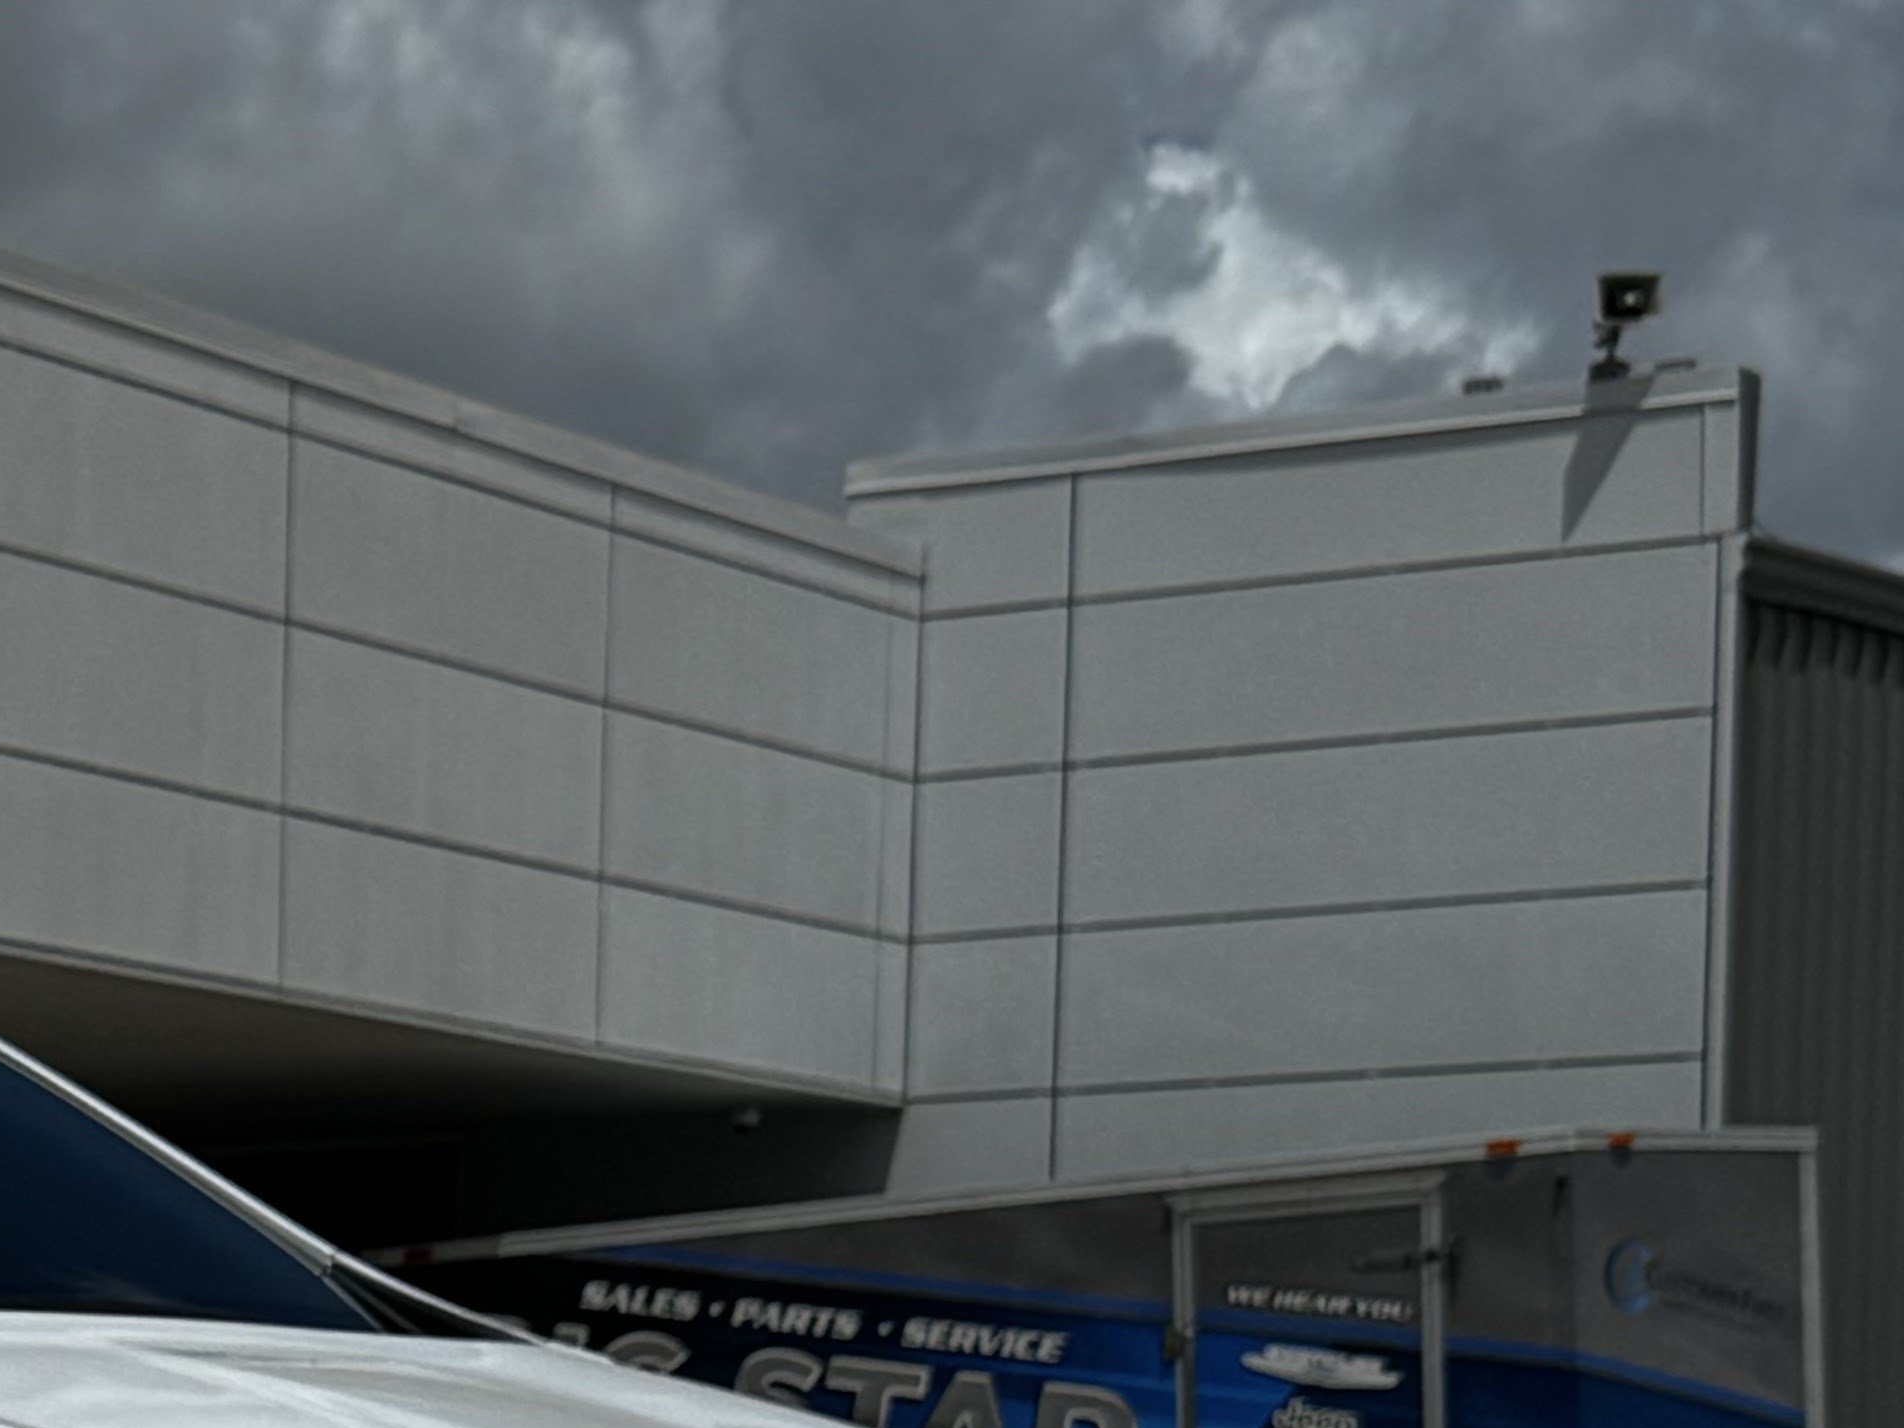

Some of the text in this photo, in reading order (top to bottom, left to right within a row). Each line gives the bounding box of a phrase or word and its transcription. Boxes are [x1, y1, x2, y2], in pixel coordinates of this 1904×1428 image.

[579, 1280, 1071, 1364] SALES PARTS SERVICE
